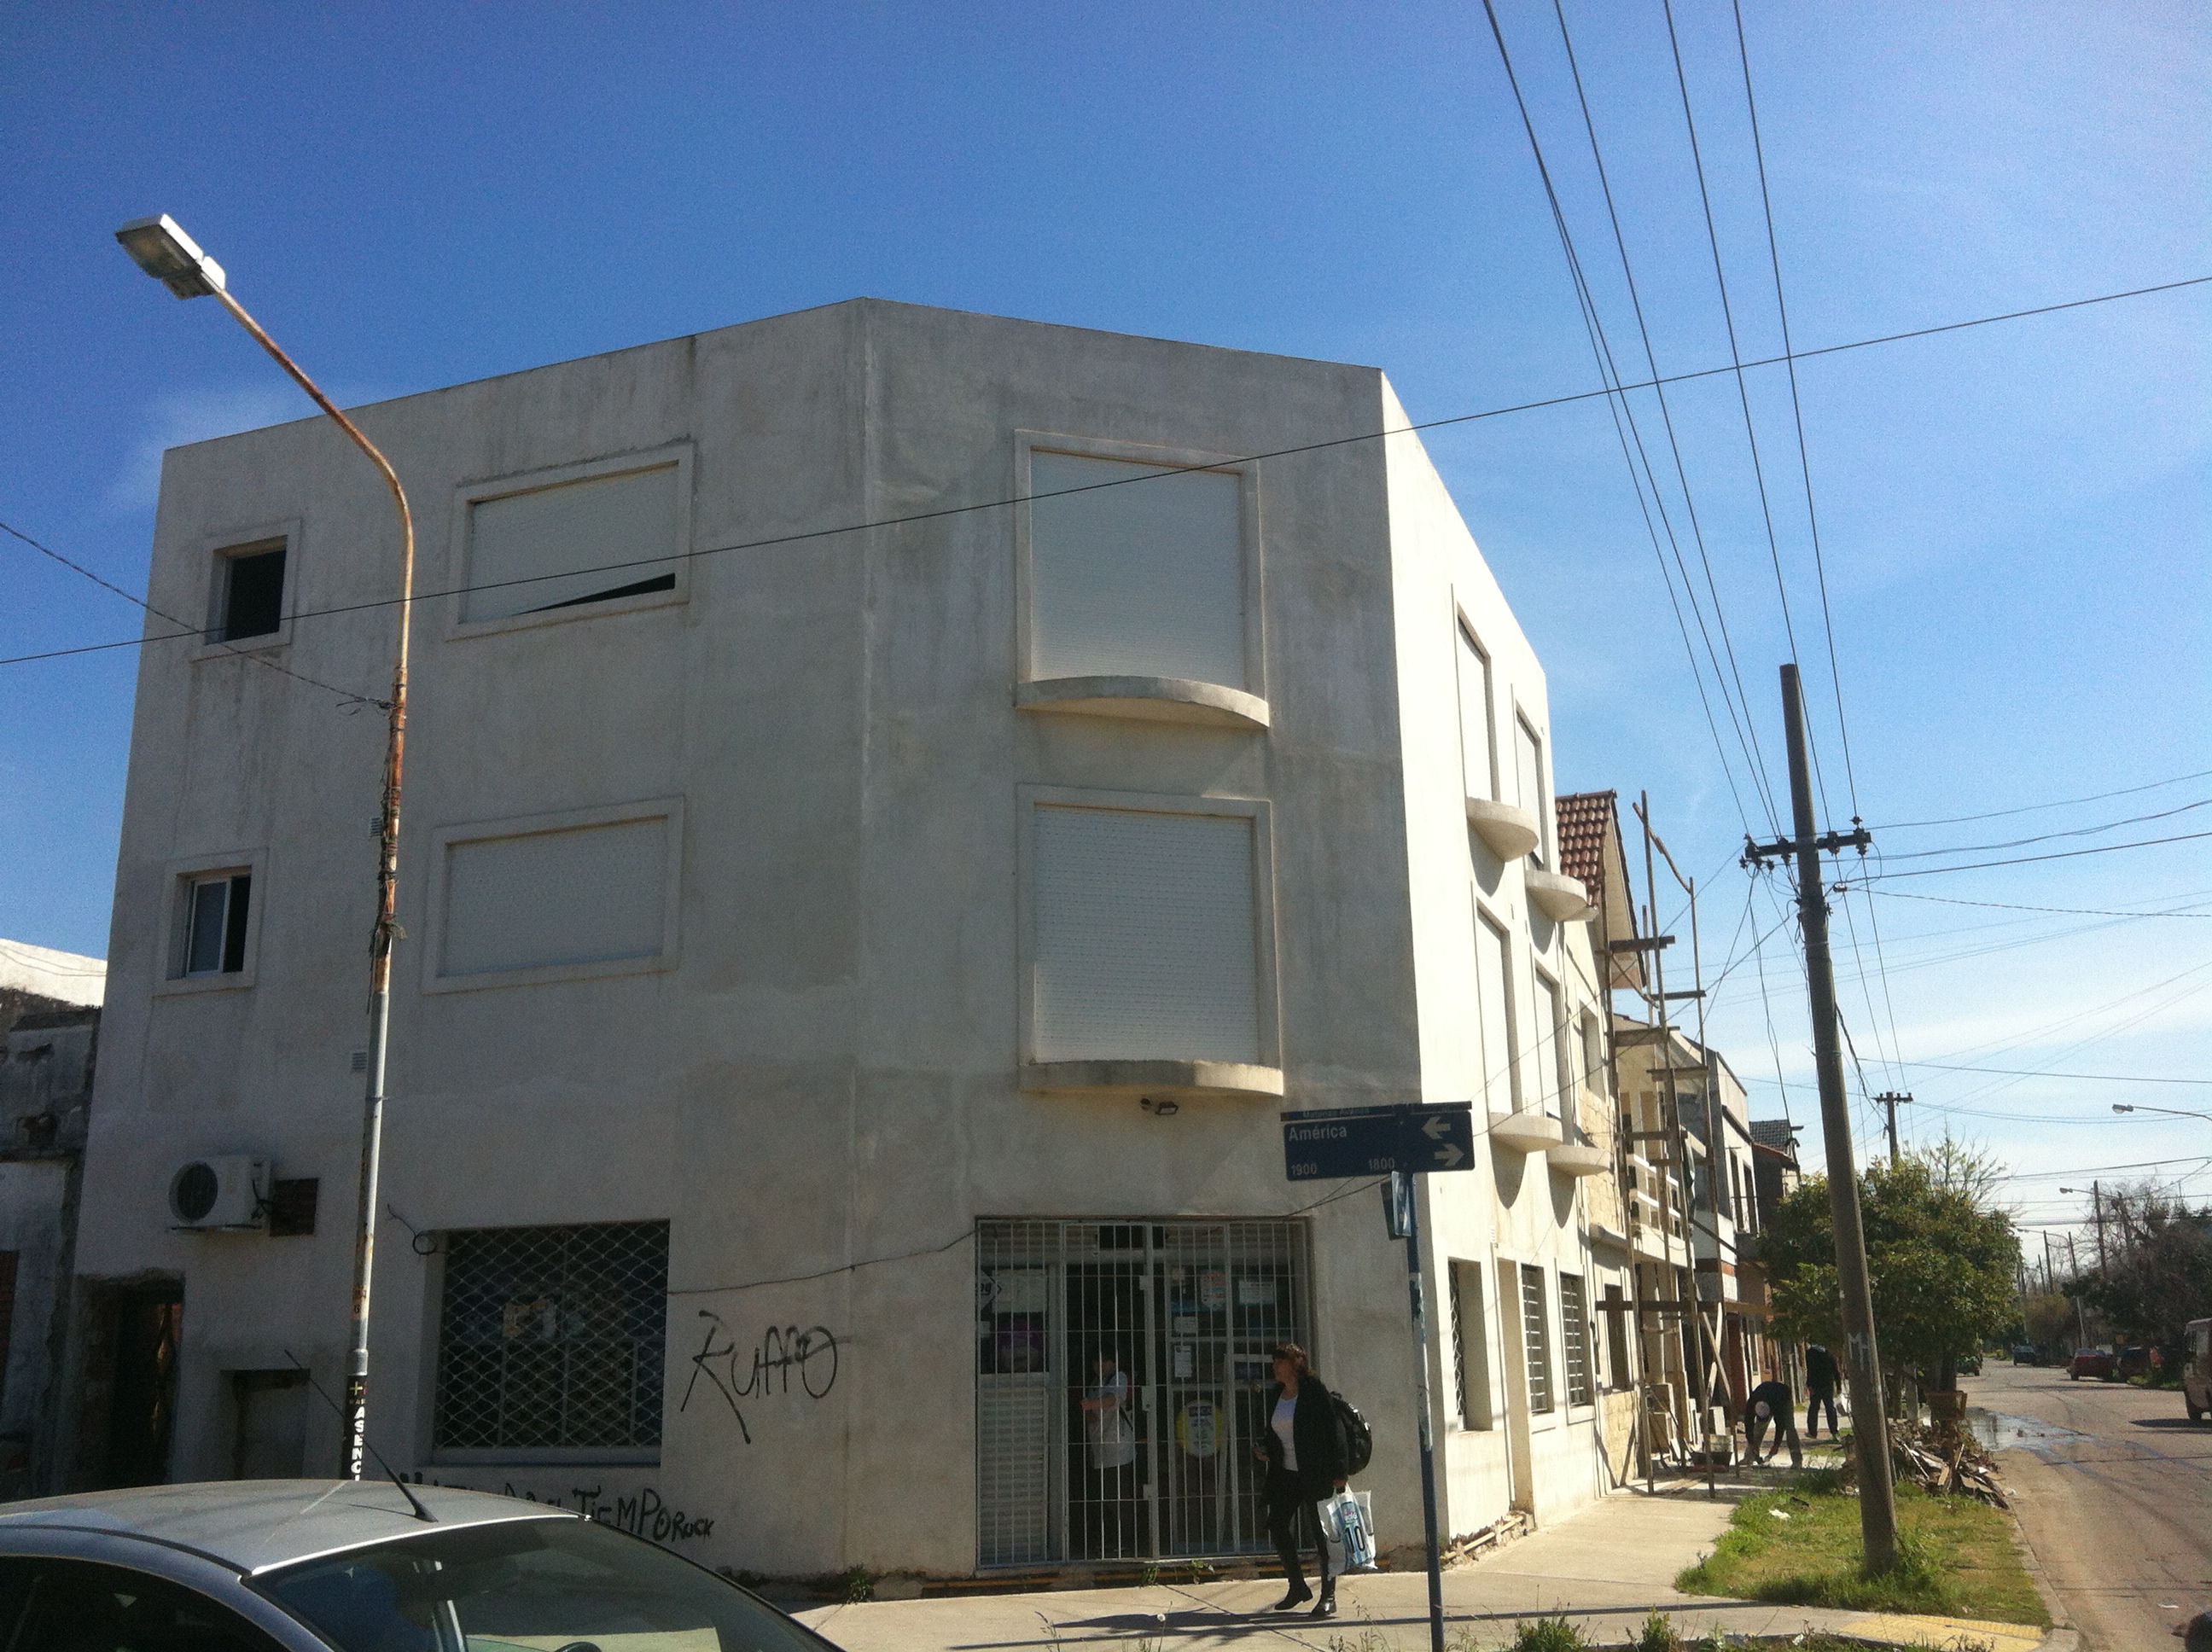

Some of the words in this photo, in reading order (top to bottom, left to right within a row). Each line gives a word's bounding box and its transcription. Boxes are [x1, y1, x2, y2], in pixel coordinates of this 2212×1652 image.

[1289, 1124, 1348, 1142] América
[1291, 1162, 1318, 1176] 1900
[1368, 1157, 1395, 1172] 1800
